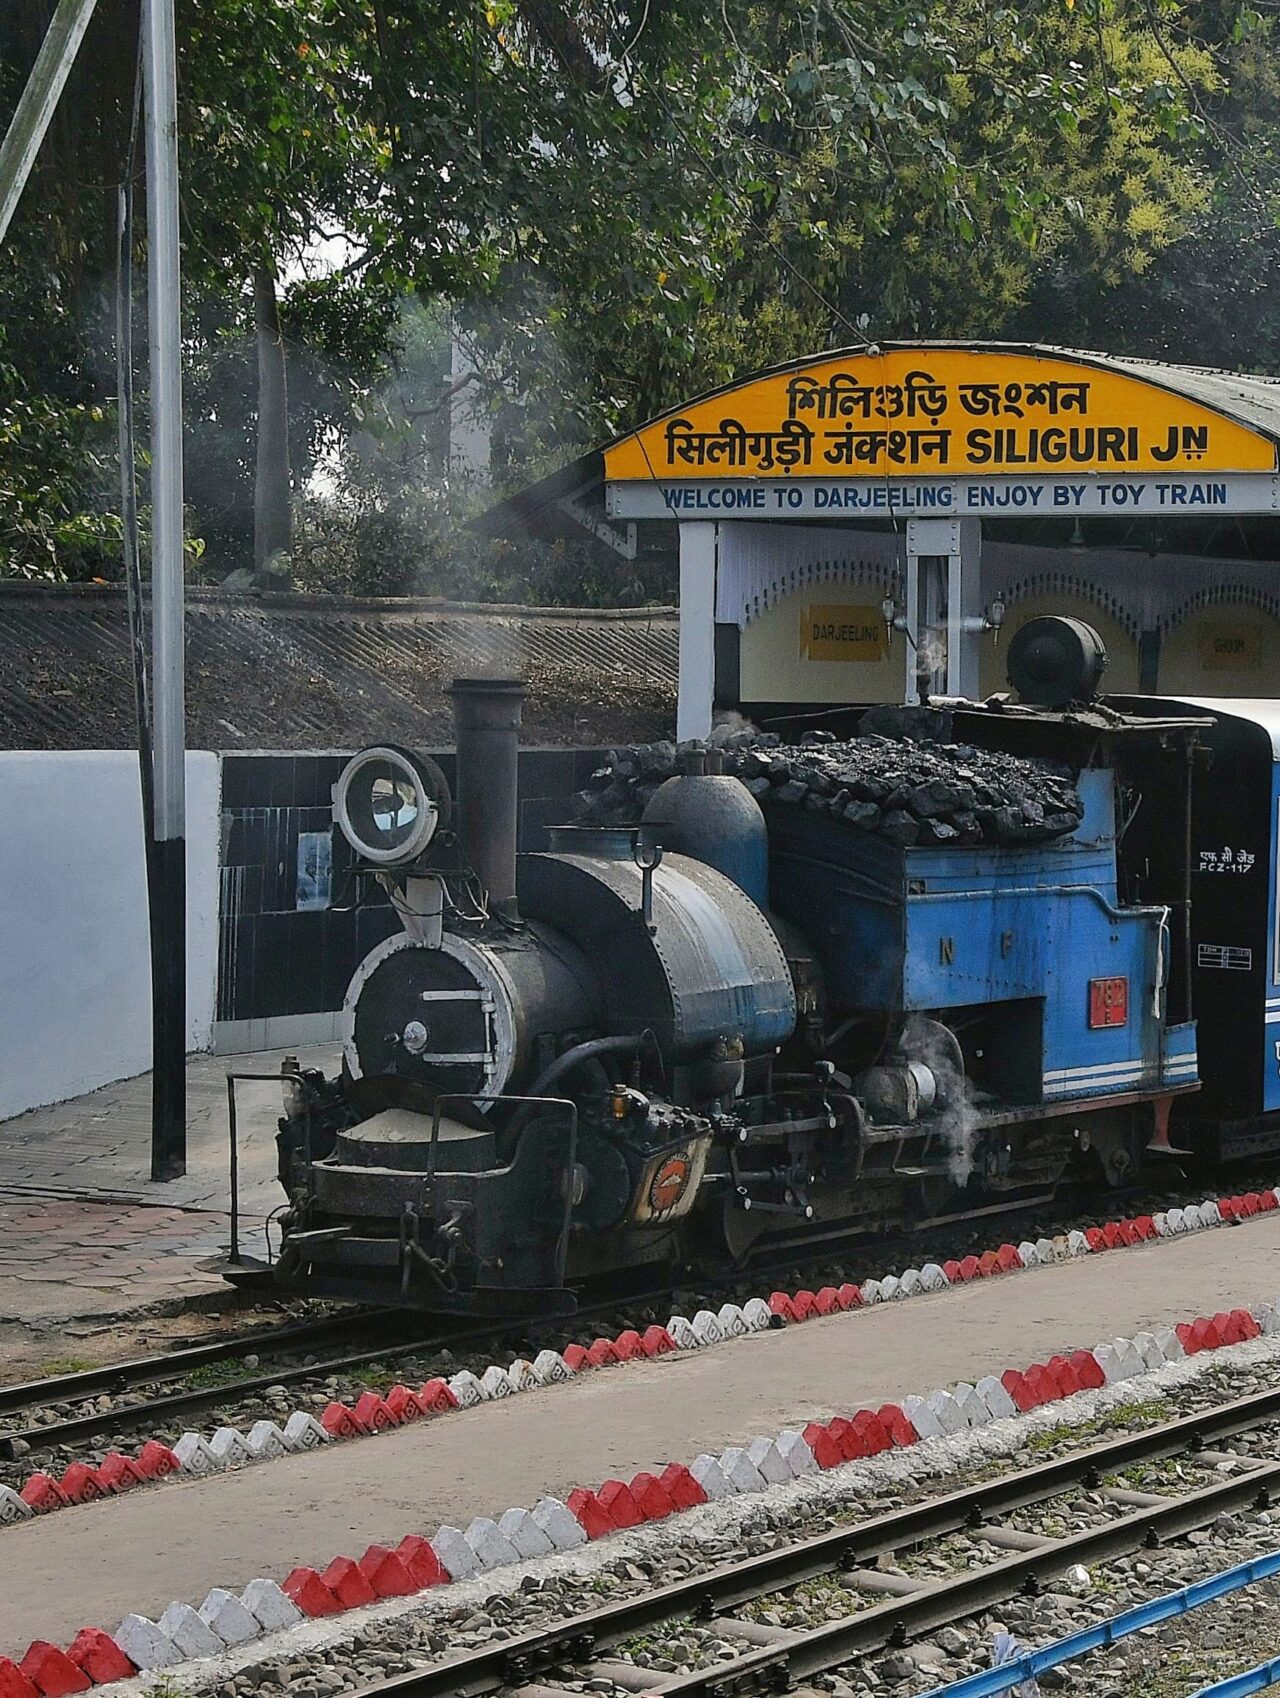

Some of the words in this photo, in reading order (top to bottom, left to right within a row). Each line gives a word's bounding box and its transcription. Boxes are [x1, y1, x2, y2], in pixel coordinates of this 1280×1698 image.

[786, 370, 948, 426] শিলিগুড়ি
[958, 381, 1090, 418] জংশন
[664, 418, 815, 474] सिलीगुड़ी
[823, 421, 953, 465] जंक्शन
[966, 426, 1139, 464] SILIGURI
[664, 488, 765, 508] WELCOME
[773, 487, 803, 508] TO
[814, 486, 952, 507] DARJEELING
[967, 485, 1044, 507] ENJOY
[1053, 485, 1087, 506] BY
[1096, 484, 1146, 506] TOY
[1155, 484, 1227, 505] TRAIN
[812, 624, 879, 642] DARJEELING
[1200, 862, 1252, 873] FCZ-117
[1094, 980, 1125, 1008] 782
